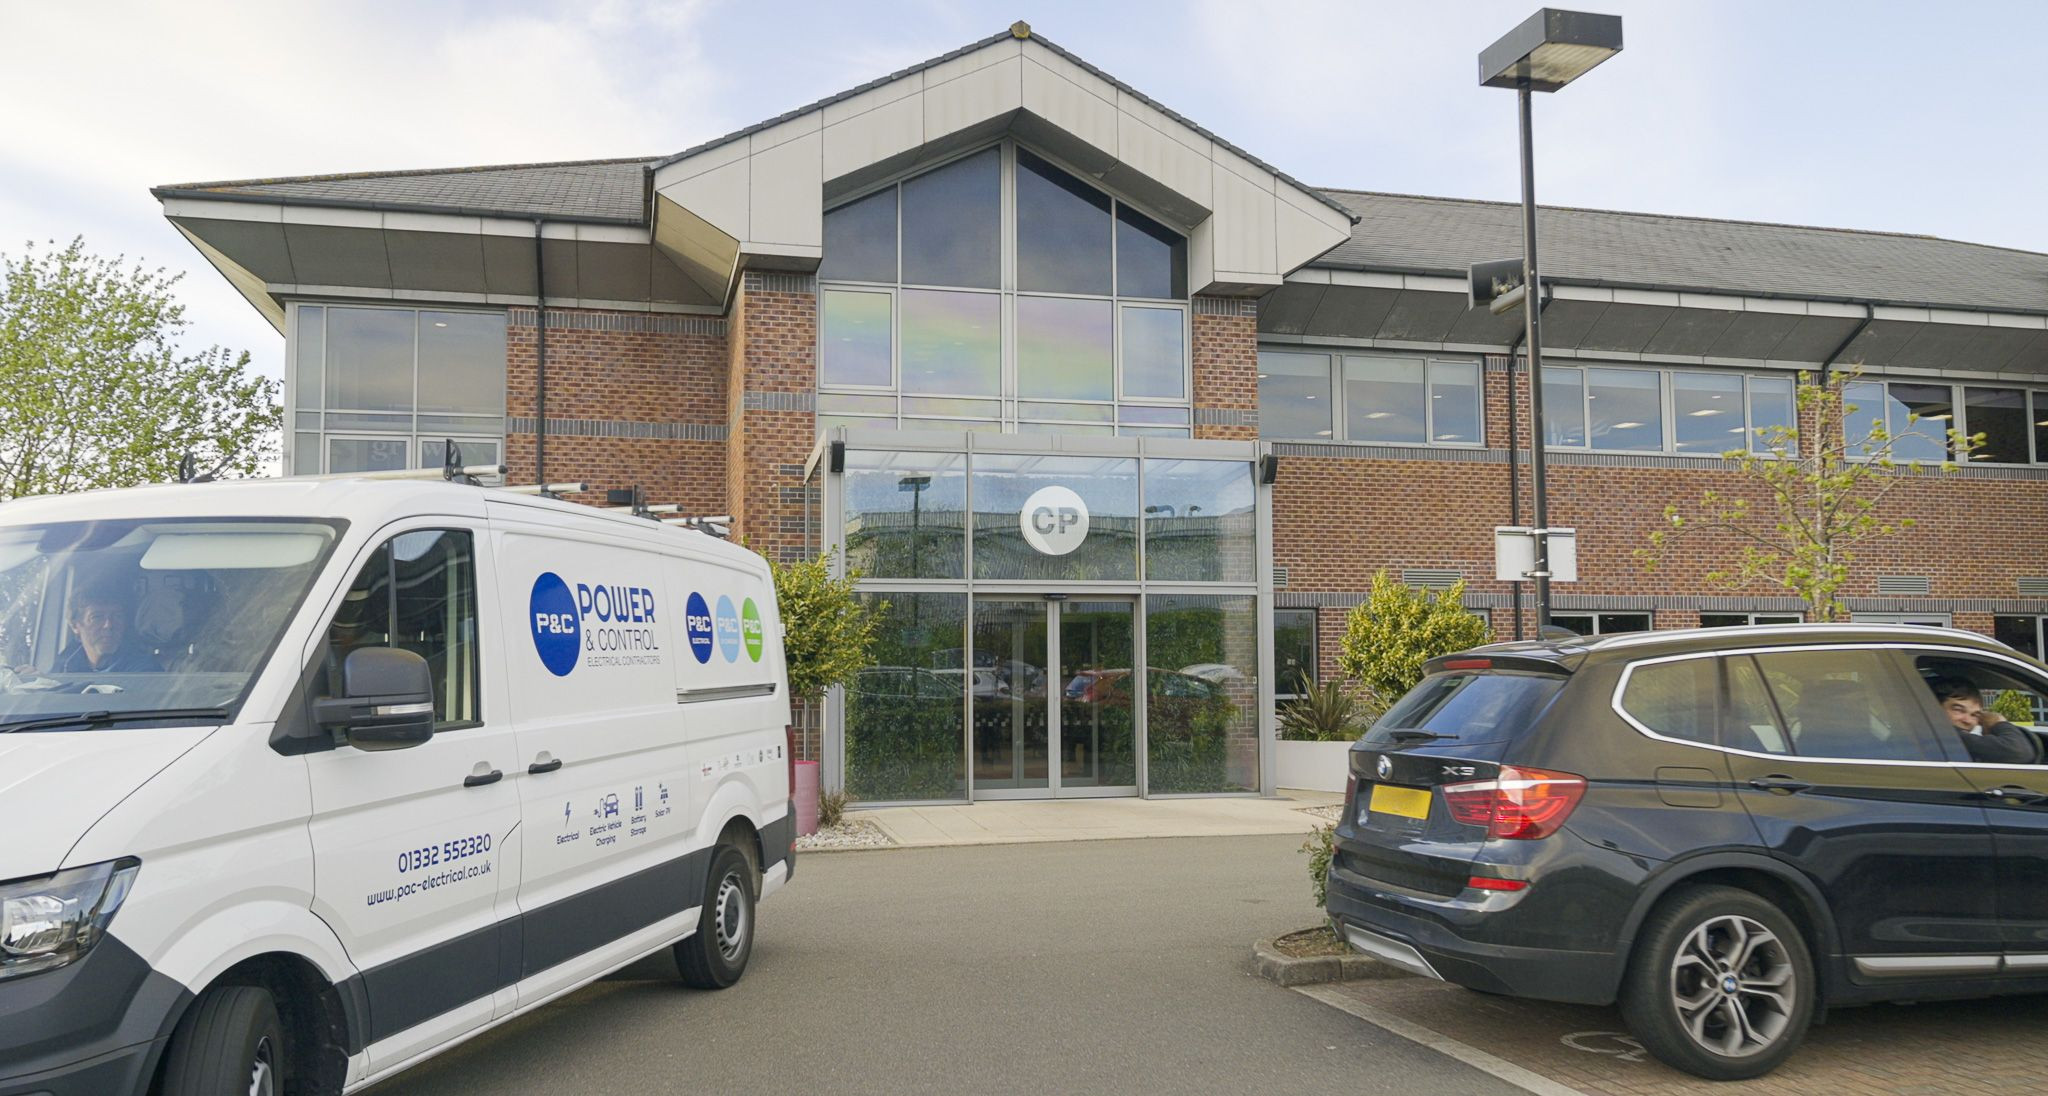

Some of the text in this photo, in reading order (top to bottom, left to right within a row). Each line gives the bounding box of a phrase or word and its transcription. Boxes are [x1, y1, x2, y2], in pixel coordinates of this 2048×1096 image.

[1032, 507, 1078, 534] CP
[577, 583, 656, 623] POWER
[536, 613, 575, 634] P&C
[687, 615, 712, 632] P&C
[718, 616, 738, 633] P&C
[743, 618, 761, 634] P&C
[586, 629, 659, 651] & CONTROL
[587, 654, 661, 667] ELECTRICAL CONTRACTORS
[1442, 765, 1476, 777] X3
[556, 831, 579, 845] Electrical
[589, 825, 607, 836] Electric
[398, 833, 492, 873] 01332 552320
[367, 860, 492, 906] www.pac-electrical.co.uk
